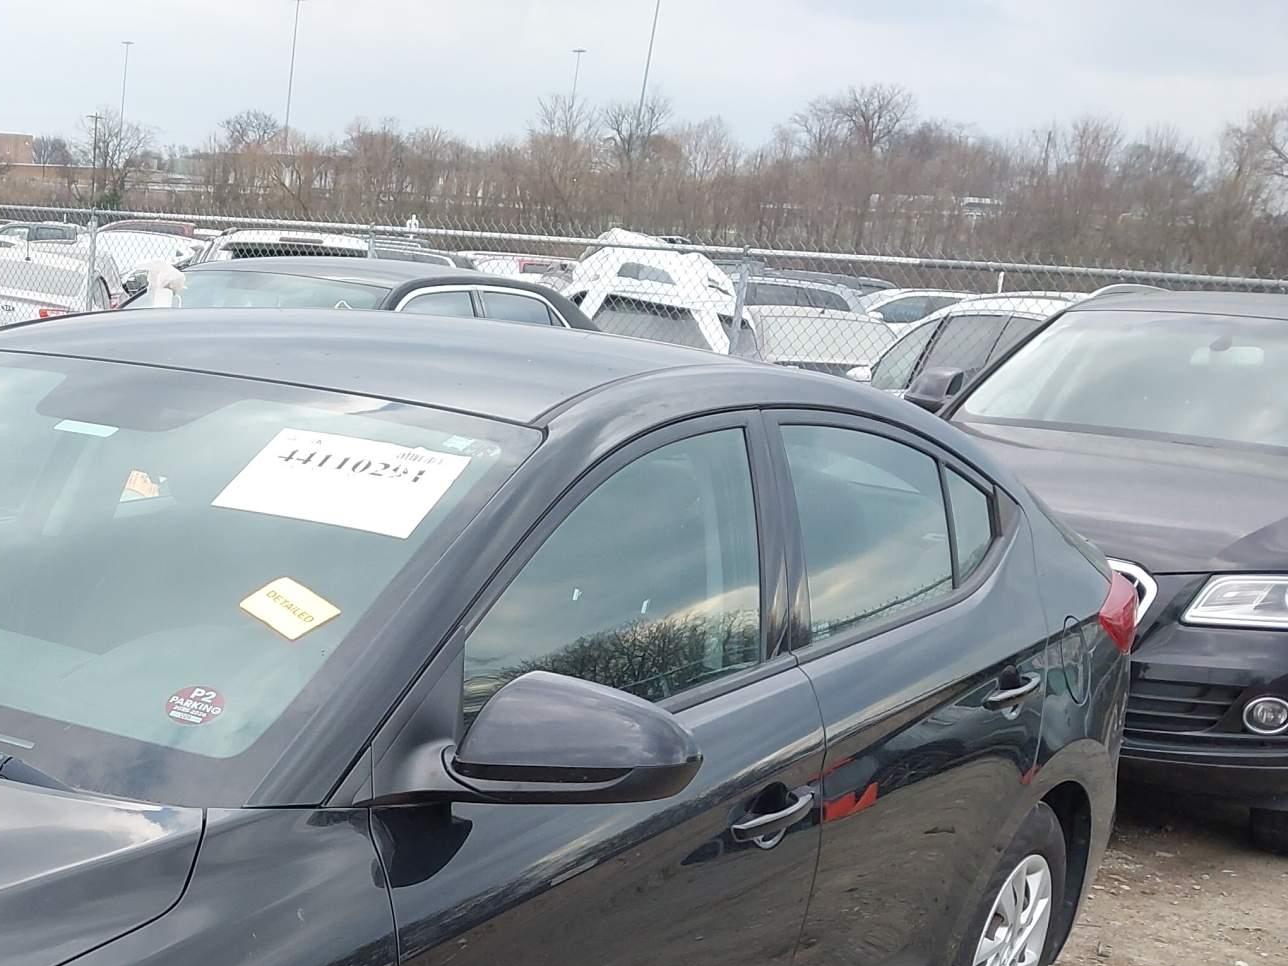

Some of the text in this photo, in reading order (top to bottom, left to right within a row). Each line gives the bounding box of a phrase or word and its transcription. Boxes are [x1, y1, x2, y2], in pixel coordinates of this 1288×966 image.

[266, 590, 314, 623] DETAILED
[168, 695, 222, 715] PARKING
[190, 687, 217, 703] P2
